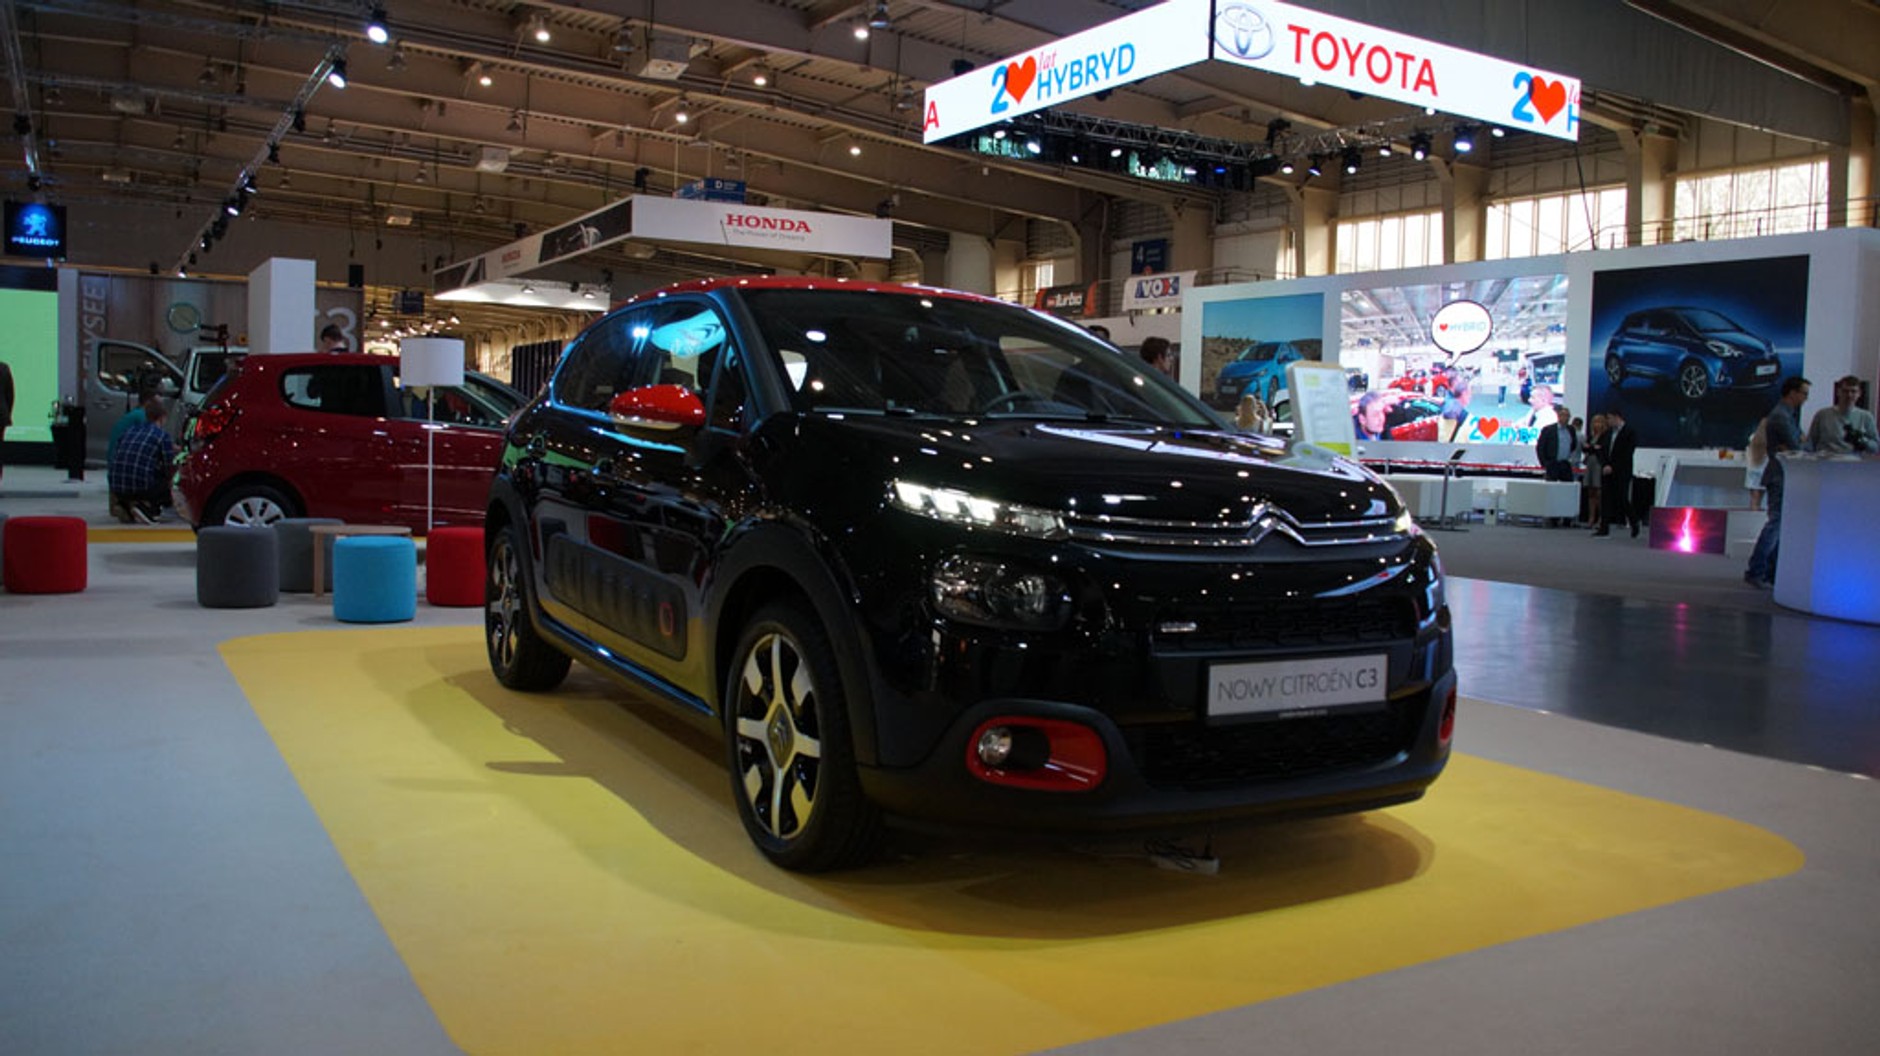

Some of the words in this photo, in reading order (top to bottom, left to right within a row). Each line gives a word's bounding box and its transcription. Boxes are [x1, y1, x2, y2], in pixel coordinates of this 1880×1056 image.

[1036, 42, 1136, 101] HYBRYD
[1038, 50, 1057, 72] lat
[1287, 24, 1438, 96] TOYOTA
[924, 100, 940, 132] A
[726, 213, 812, 233] HONDA
[11, 236, 60, 247] PEUGEOT
[1056, 291, 1083, 308] turbo
[1217, 677, 1277, 701] NOWY
[1356, 668, 1378, 690] C3
